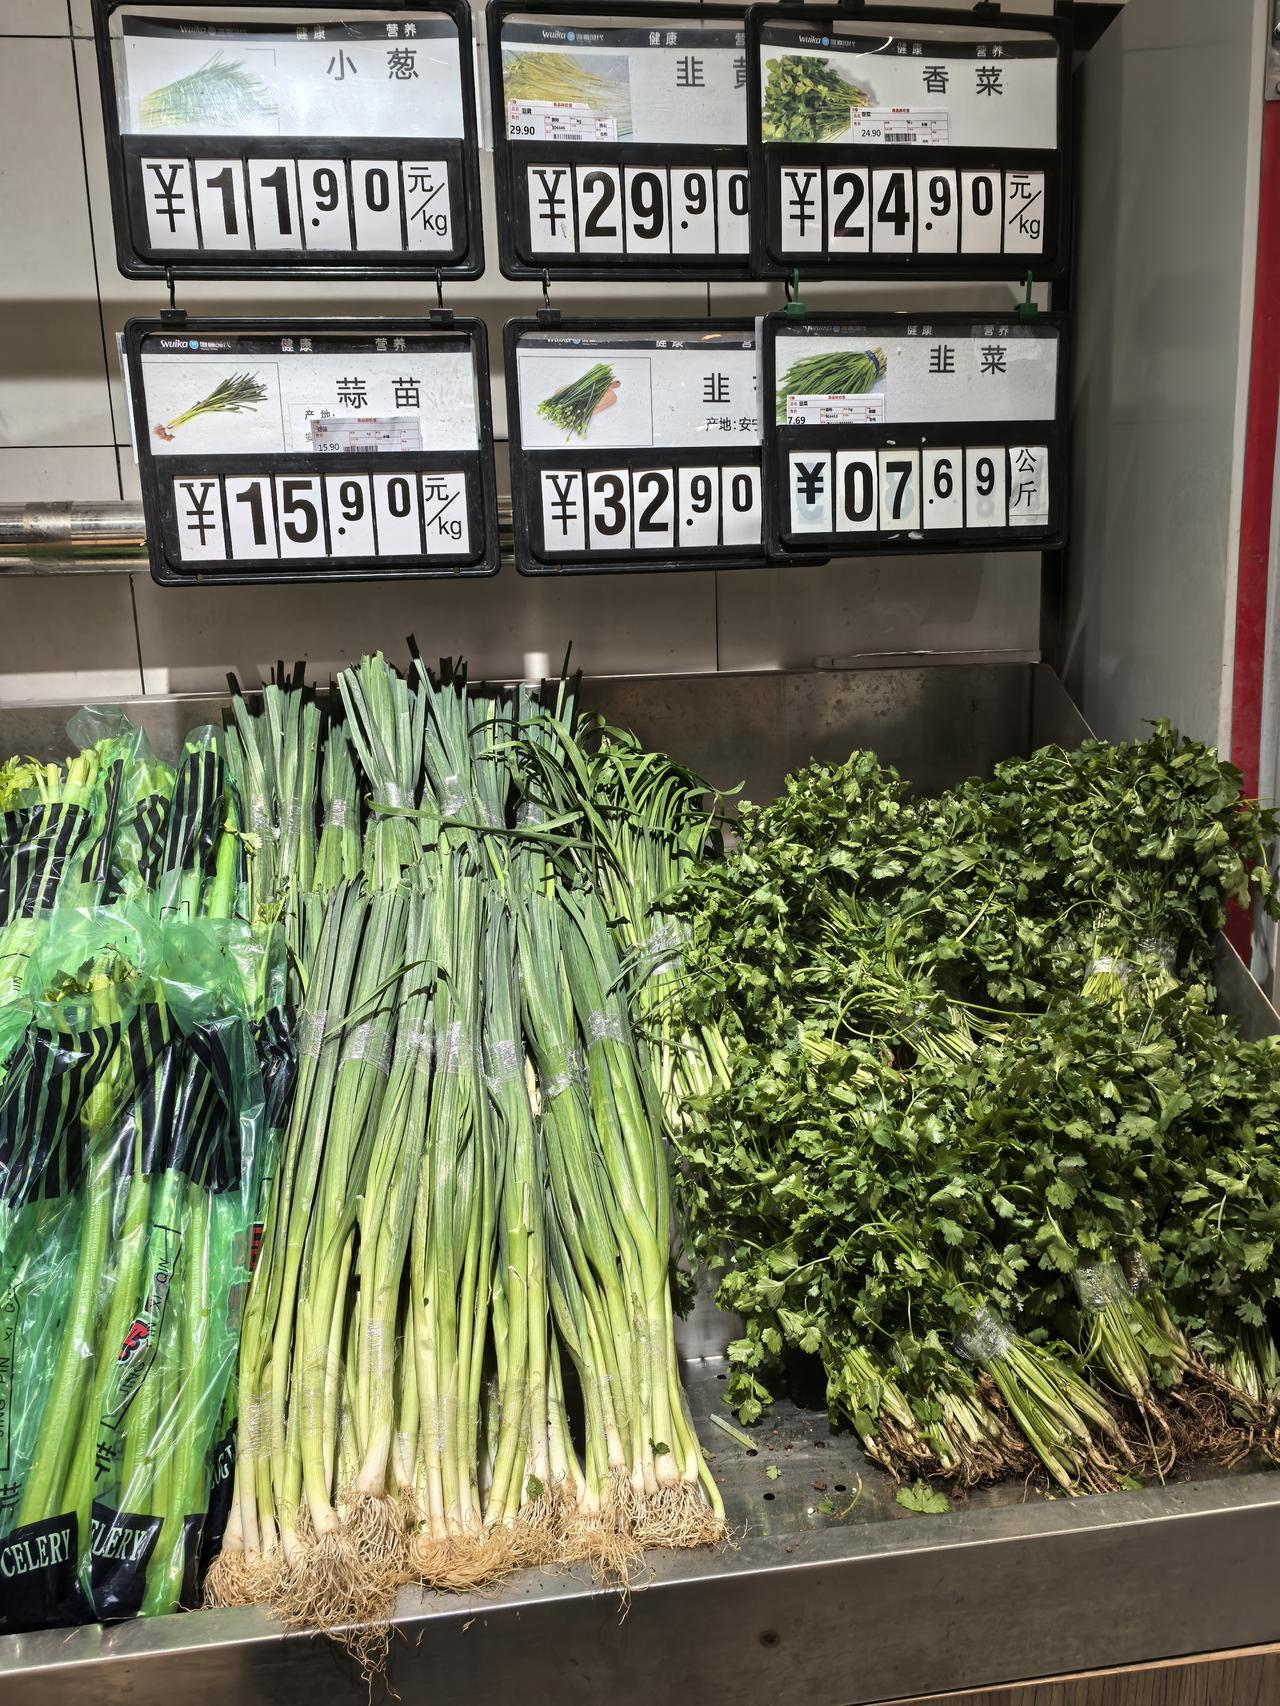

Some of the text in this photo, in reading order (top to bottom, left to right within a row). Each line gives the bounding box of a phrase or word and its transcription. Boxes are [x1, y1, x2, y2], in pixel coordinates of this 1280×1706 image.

[386, 23, 417, 37] 营养
[648, 31, 677, 46] 健康
[896, 41, 1004, 58] 健康 营养
[326, 47, 419, 80] 小葱
[922, 65, 1004, 96] 香菜
[510, 125, 535, 135] 29.90
[861, 129, 881, 138] 24.90
[280, 337, 407, 352] 健康 营养
[929, 344, 1008, 375] 韭菜
[336, 377, 422, 409] 蒜苗
[787, 416, 806, 425] 7.69
[318, 442, 340, 452] 15.90
[1013, 448, 1038, 508] 公斤
[154, 1256, 169, 1285] QIN
[0, 1528, 71, 1578] CELERY
